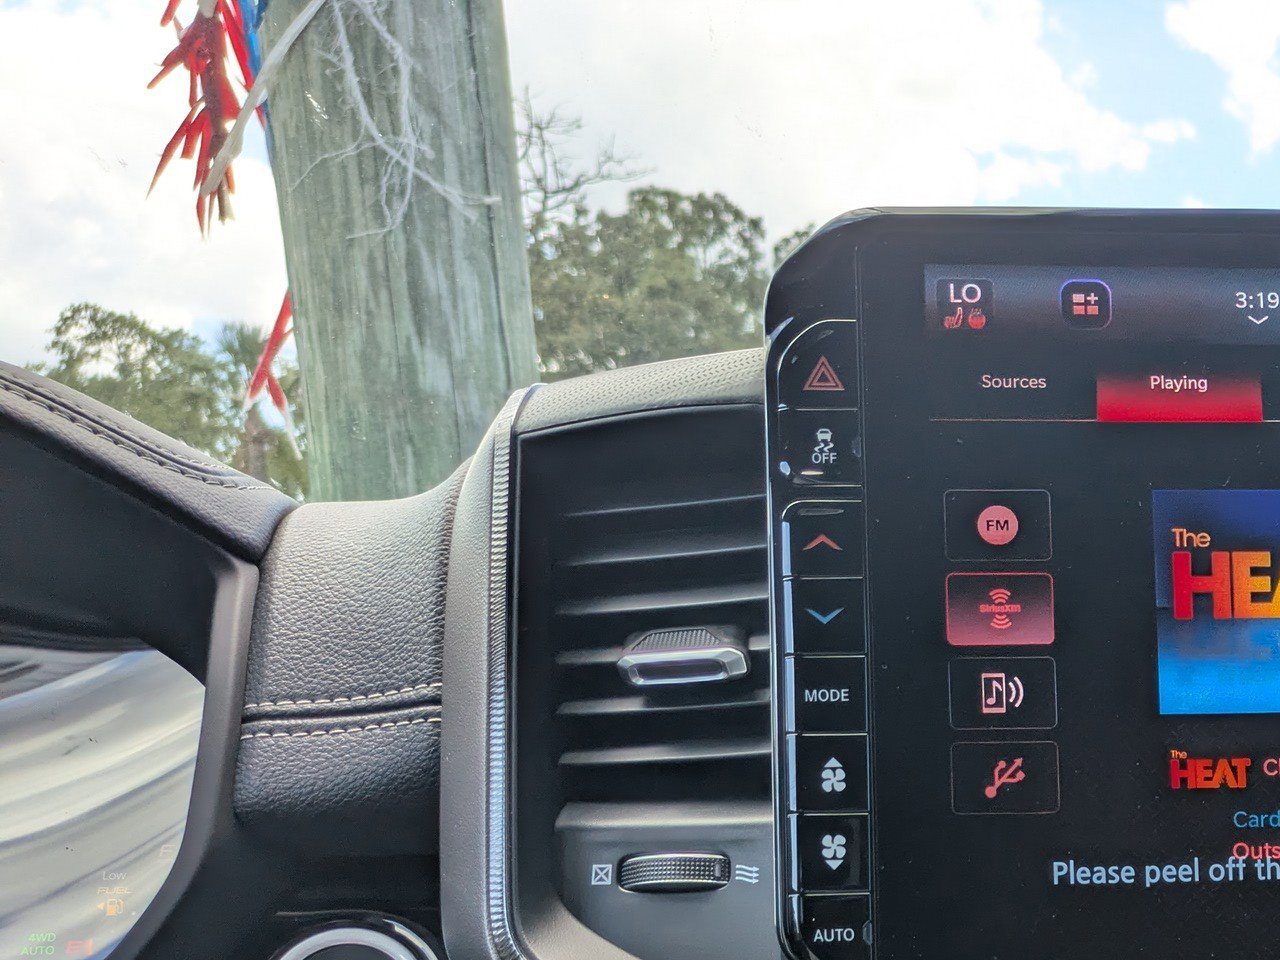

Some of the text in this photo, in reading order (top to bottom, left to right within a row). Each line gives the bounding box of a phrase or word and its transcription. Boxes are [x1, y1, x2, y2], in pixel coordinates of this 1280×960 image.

[949, 283, 982, 303] LO
[1234, 291, 1280, 309] 3:19
[981, 374, 1047, 389] Sources
[1149, 374, 1209, 393] Playing
[811, 452, 838, 464] OFF
[985, 519, 1010, 532] FM
[1171, 527, 1211, 548] The
[804, 688, 850, 702] MODE
[1169, 749, 1188, 760] The
[1169, 757, 1252, 790] HEAT
[1052, 860, 1135, 885] Please
[1144, 857, 1200, 887] peel
[1208, 855, 1247, 882] off
[813, 928, 855, 943] AUTO
[20, 945, 55, 956] AUTO
